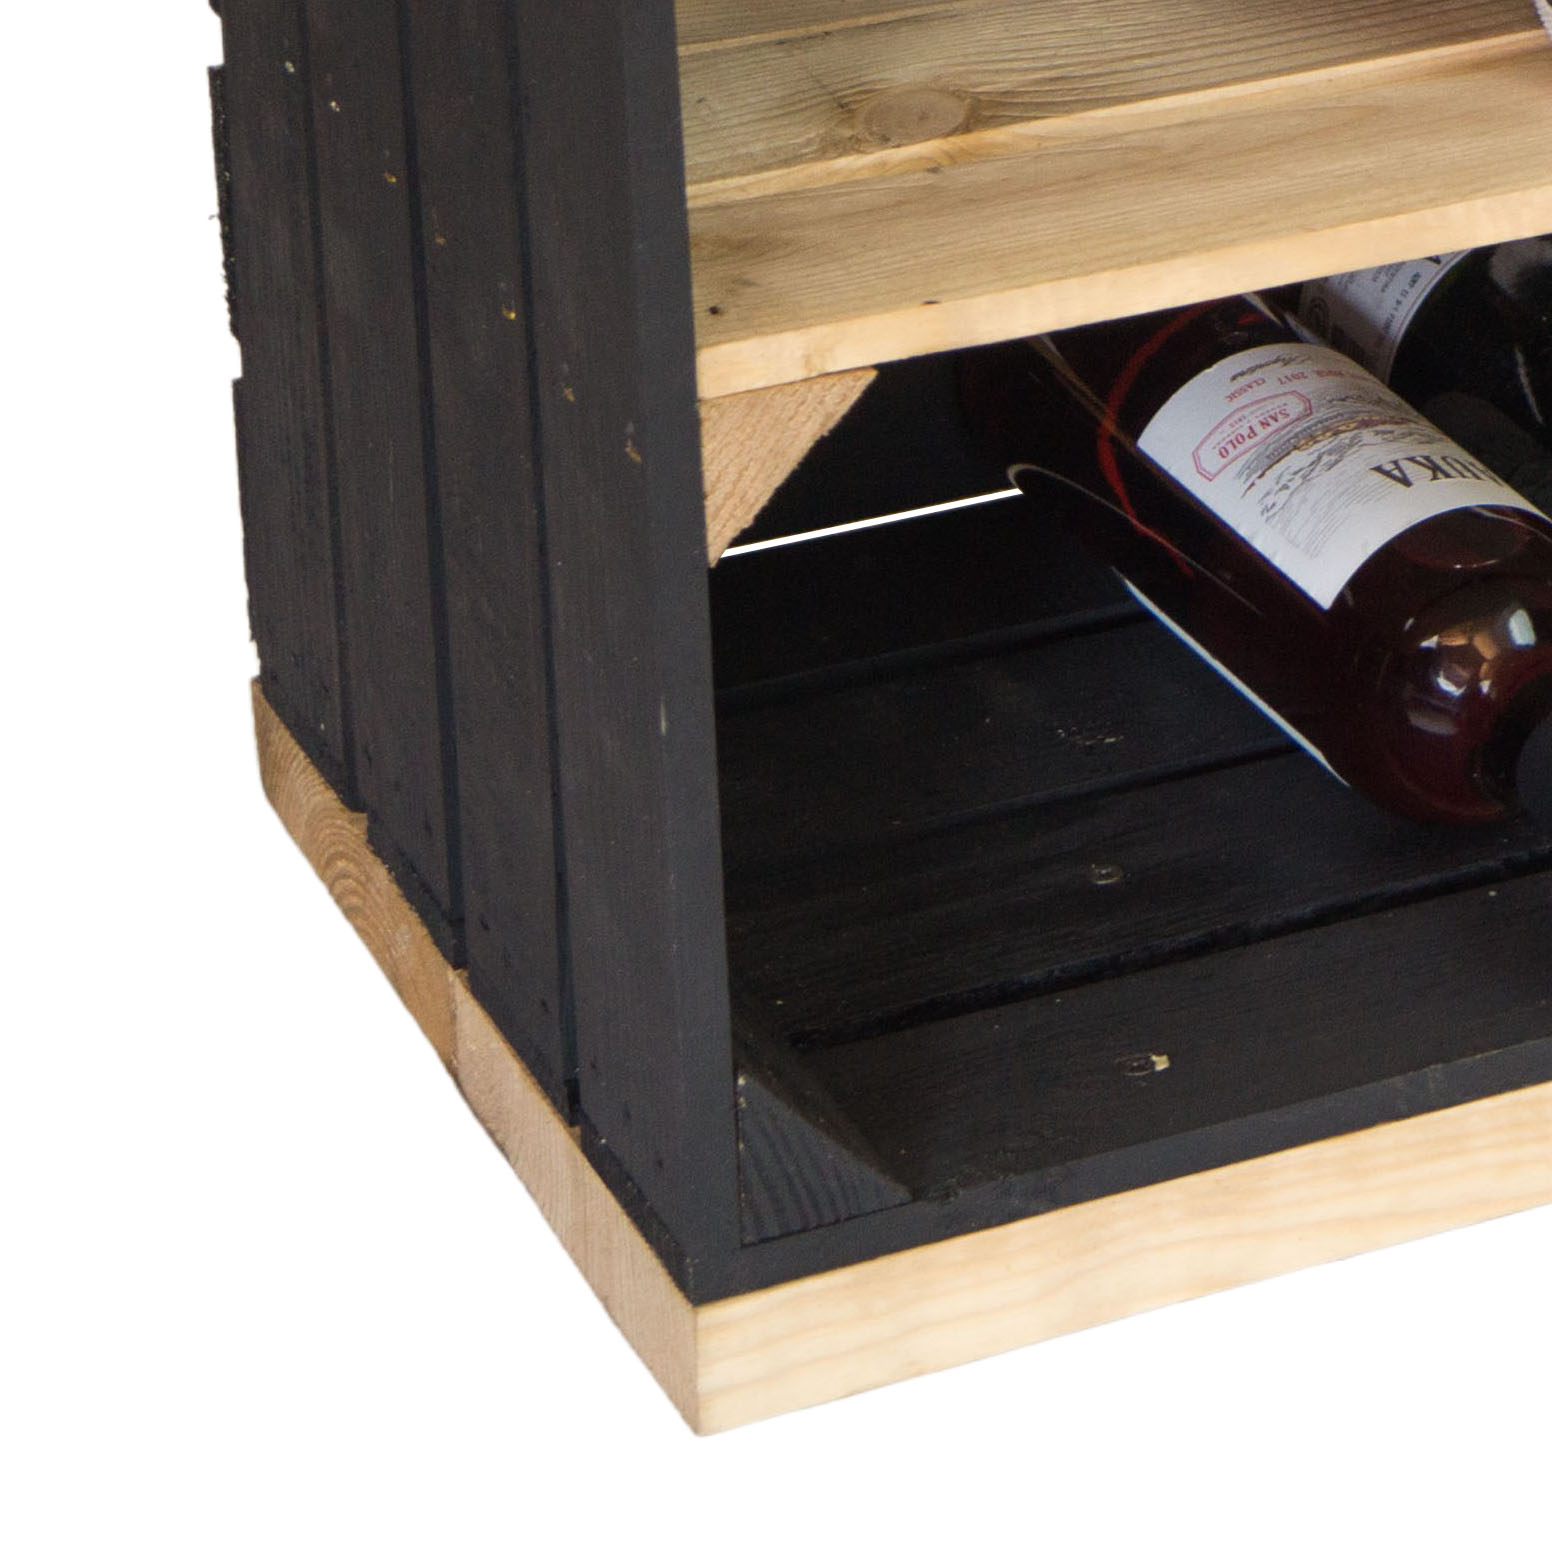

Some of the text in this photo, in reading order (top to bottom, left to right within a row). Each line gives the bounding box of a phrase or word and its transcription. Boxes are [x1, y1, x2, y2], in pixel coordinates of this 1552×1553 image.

[1225, 376, 1267, 403] CLASSIC
[1277, 370, 1309, 386] 2017
[1257, 407, 1291, 431] SAN
[1216, 424, 1258, 460] POLO
